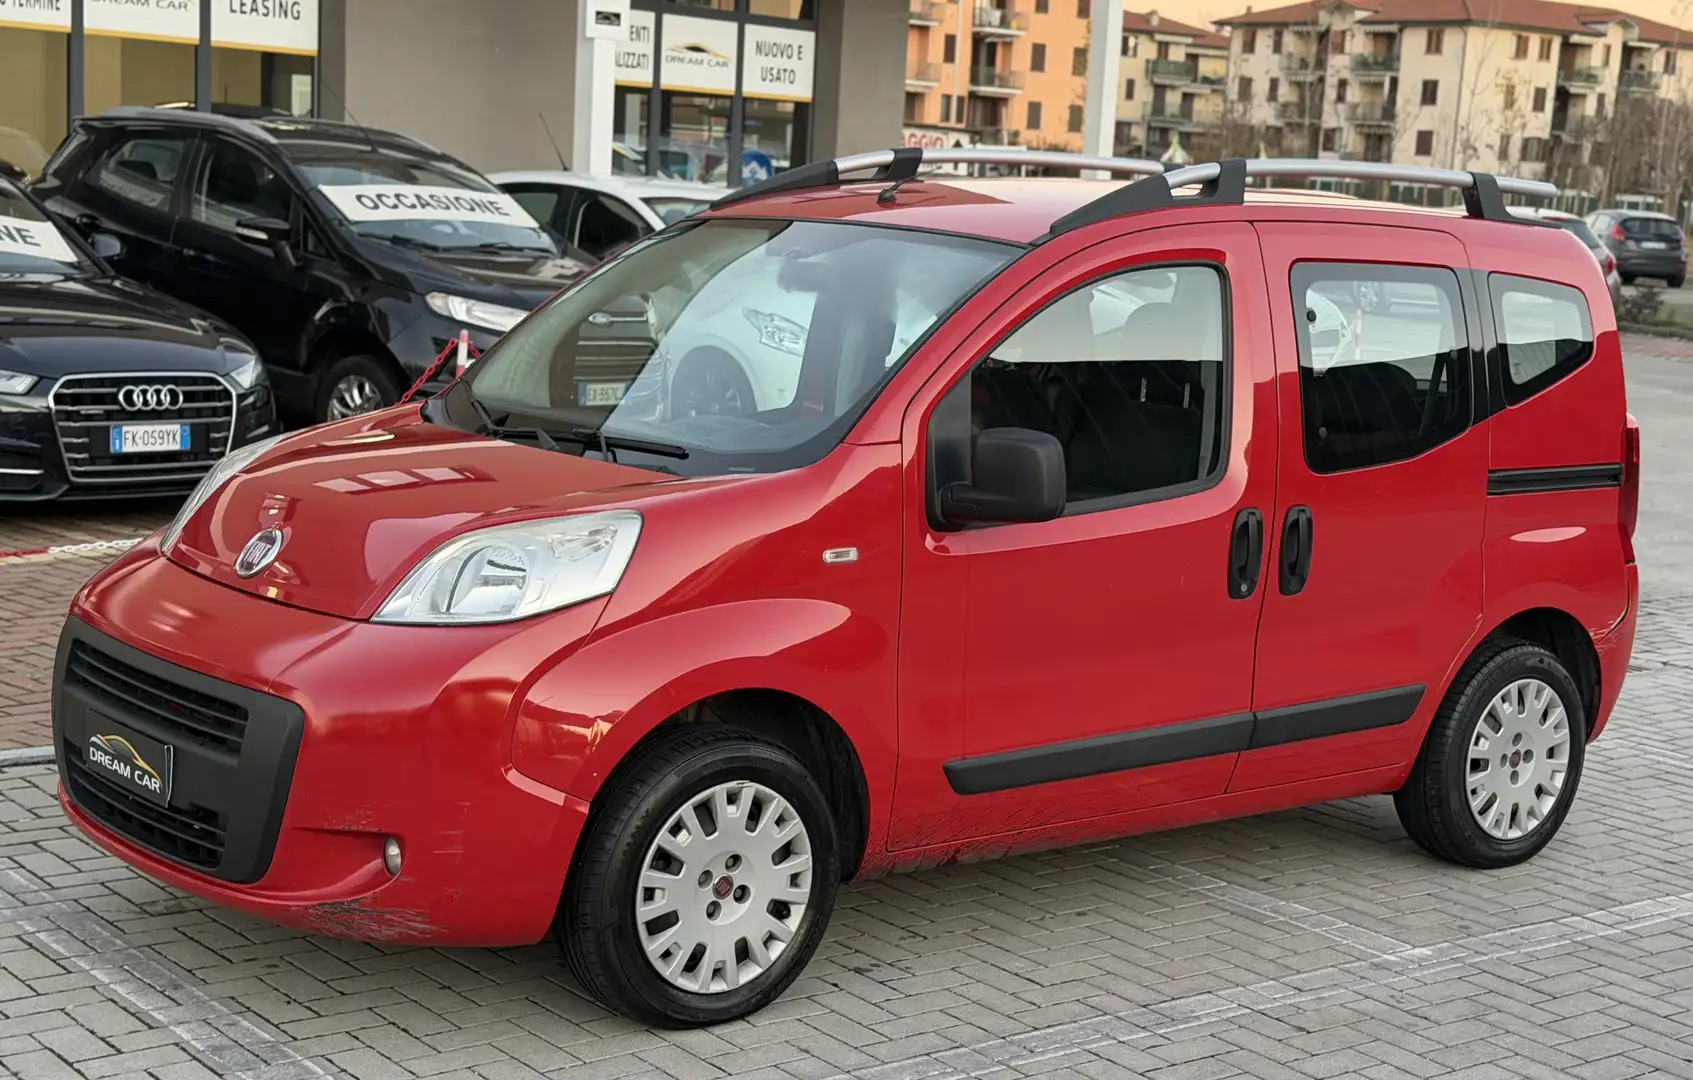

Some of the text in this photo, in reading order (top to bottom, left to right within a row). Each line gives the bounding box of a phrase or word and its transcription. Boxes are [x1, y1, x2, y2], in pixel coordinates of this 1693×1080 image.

[155, 0, 189, 11] CAR
[229, 0, 301, 21] LEASING
[755, 40, 804, 61] NUOVO E
[665, 54, 729, 69] DREAM CAR
[760, 66, 796, 85] USATO
[355, 193, 512, 217] OCCASIONE
[89, 746, 161, 794] DREAM CAR
